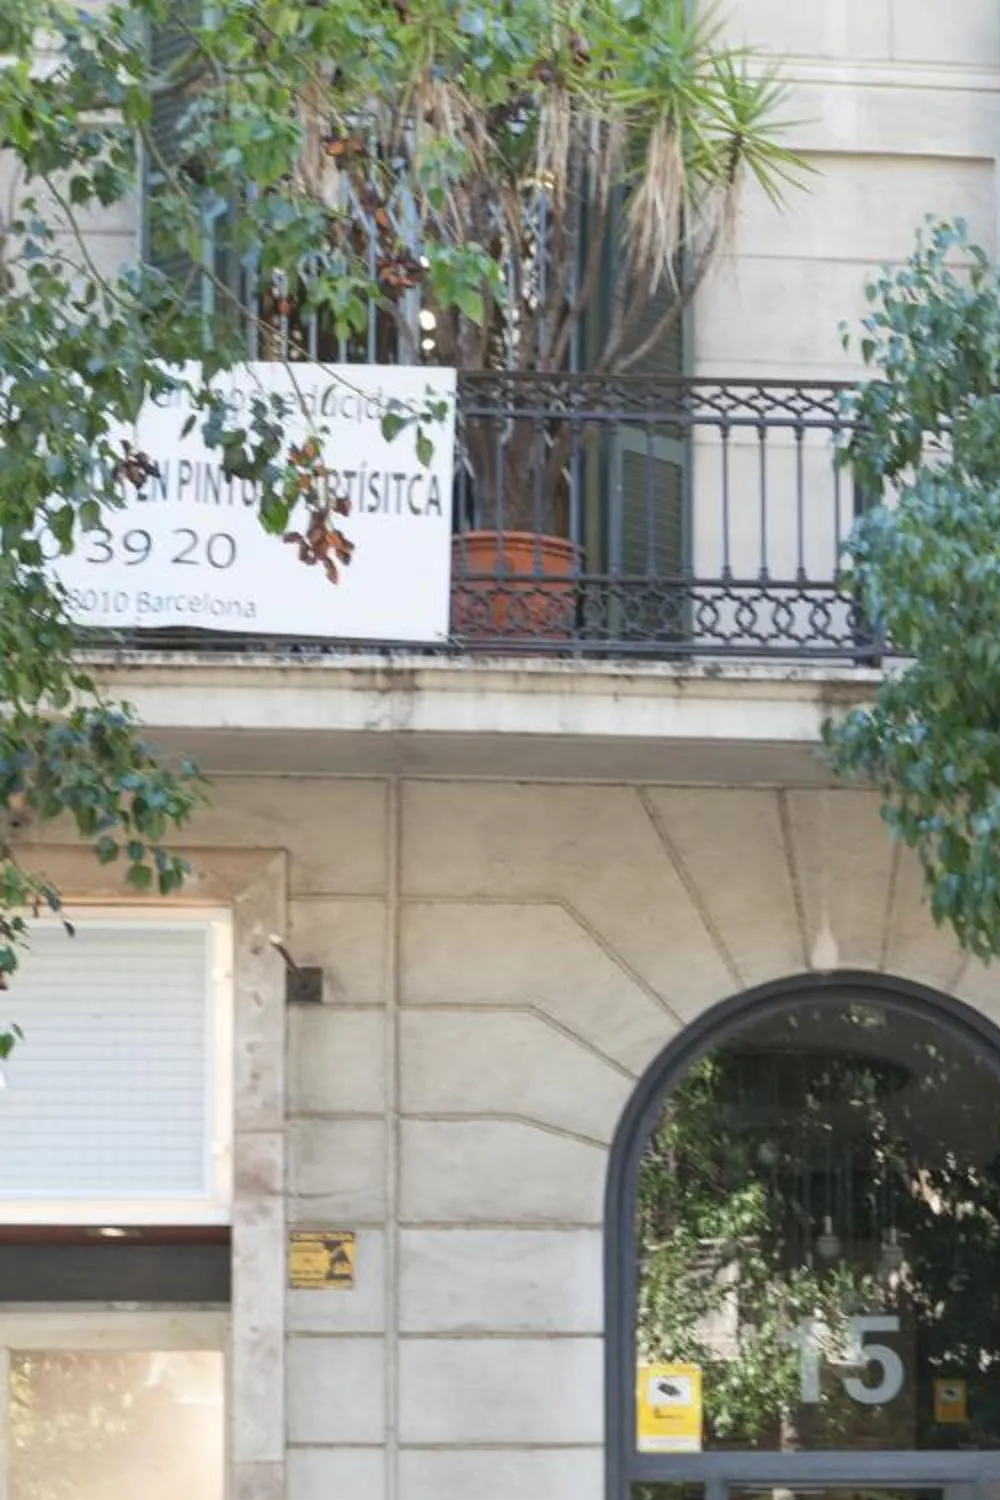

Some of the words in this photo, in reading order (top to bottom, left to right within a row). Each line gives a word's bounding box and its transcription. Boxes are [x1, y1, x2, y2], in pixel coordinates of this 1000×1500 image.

[85, 527, 153, 566] 39
[171, 527, 236, 569] 20
[136, 590, 256, 618] Barcelona
